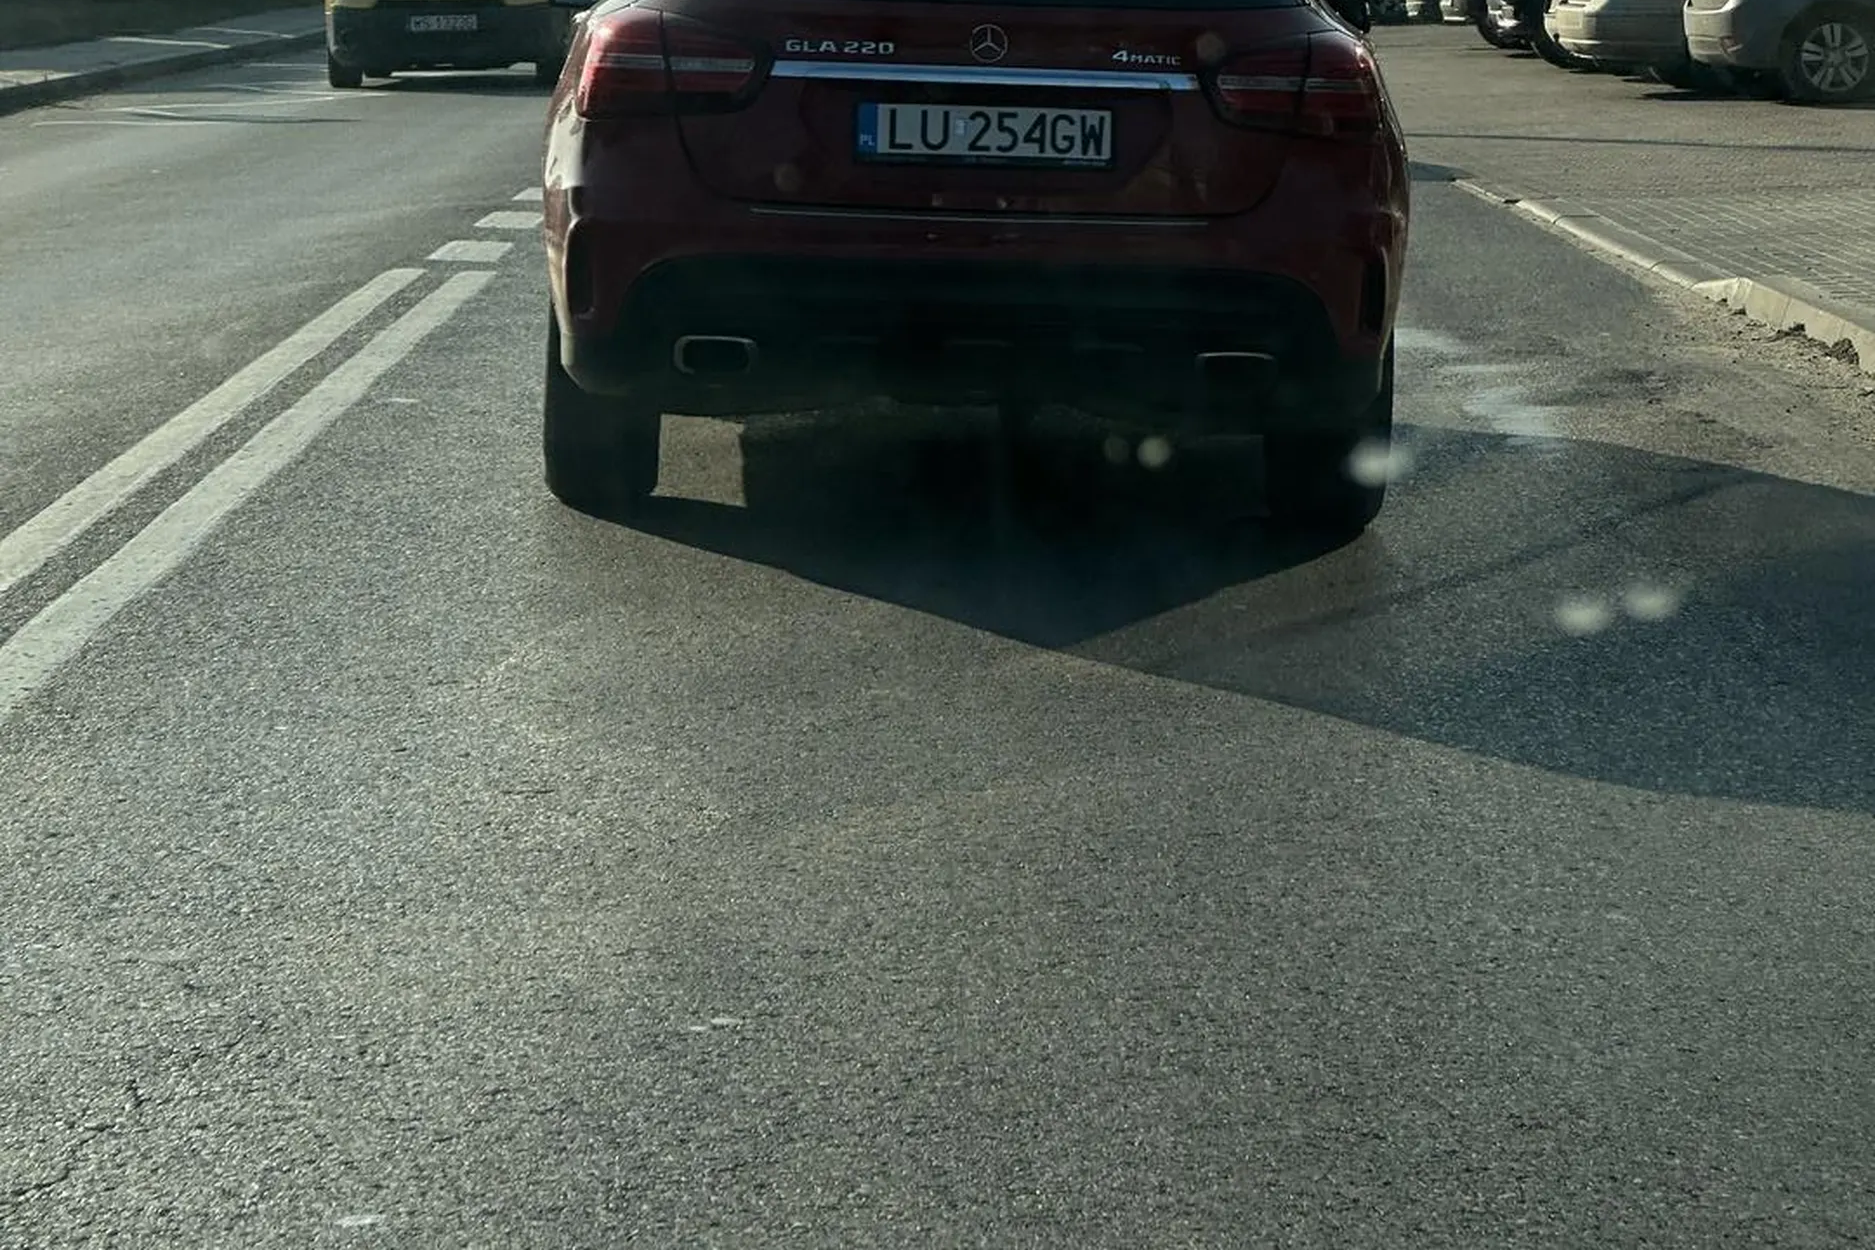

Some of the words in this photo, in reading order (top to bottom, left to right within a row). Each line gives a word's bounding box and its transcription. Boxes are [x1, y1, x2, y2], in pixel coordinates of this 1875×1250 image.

[785, 38, 837, 53] GLA
[843, 40, 895, 55] 220
[1111, 49, 1182, 66] 4MATIC
[859, 133, 876, 147] PL
[888, 108, 950, 151] LU
[967, 111, 1105, 157] 254GW
